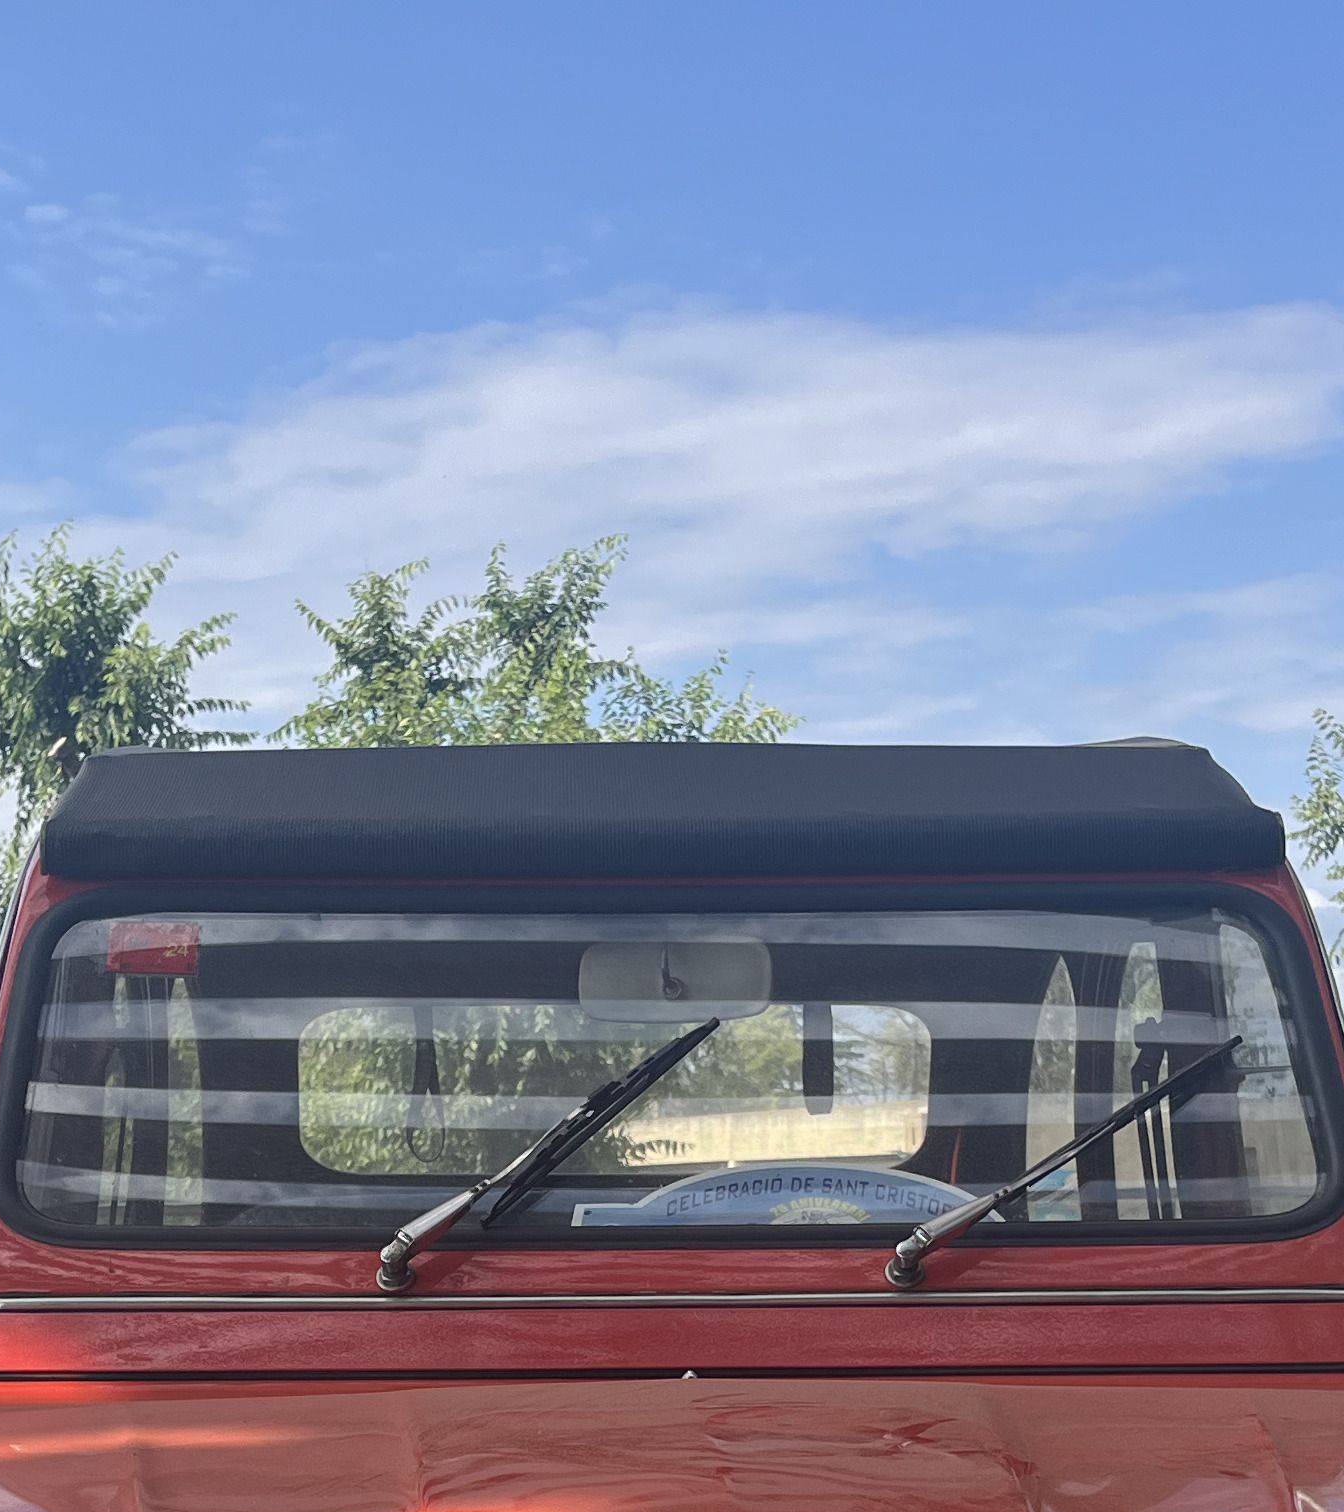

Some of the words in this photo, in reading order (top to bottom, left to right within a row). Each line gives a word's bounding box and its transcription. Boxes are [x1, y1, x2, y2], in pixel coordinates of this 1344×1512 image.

[666, 1173, 783, 1217] CELEBRACIÓ
[790, 1176, 815, 1193] DE
[821, 1177, 869, 1198] SANT
